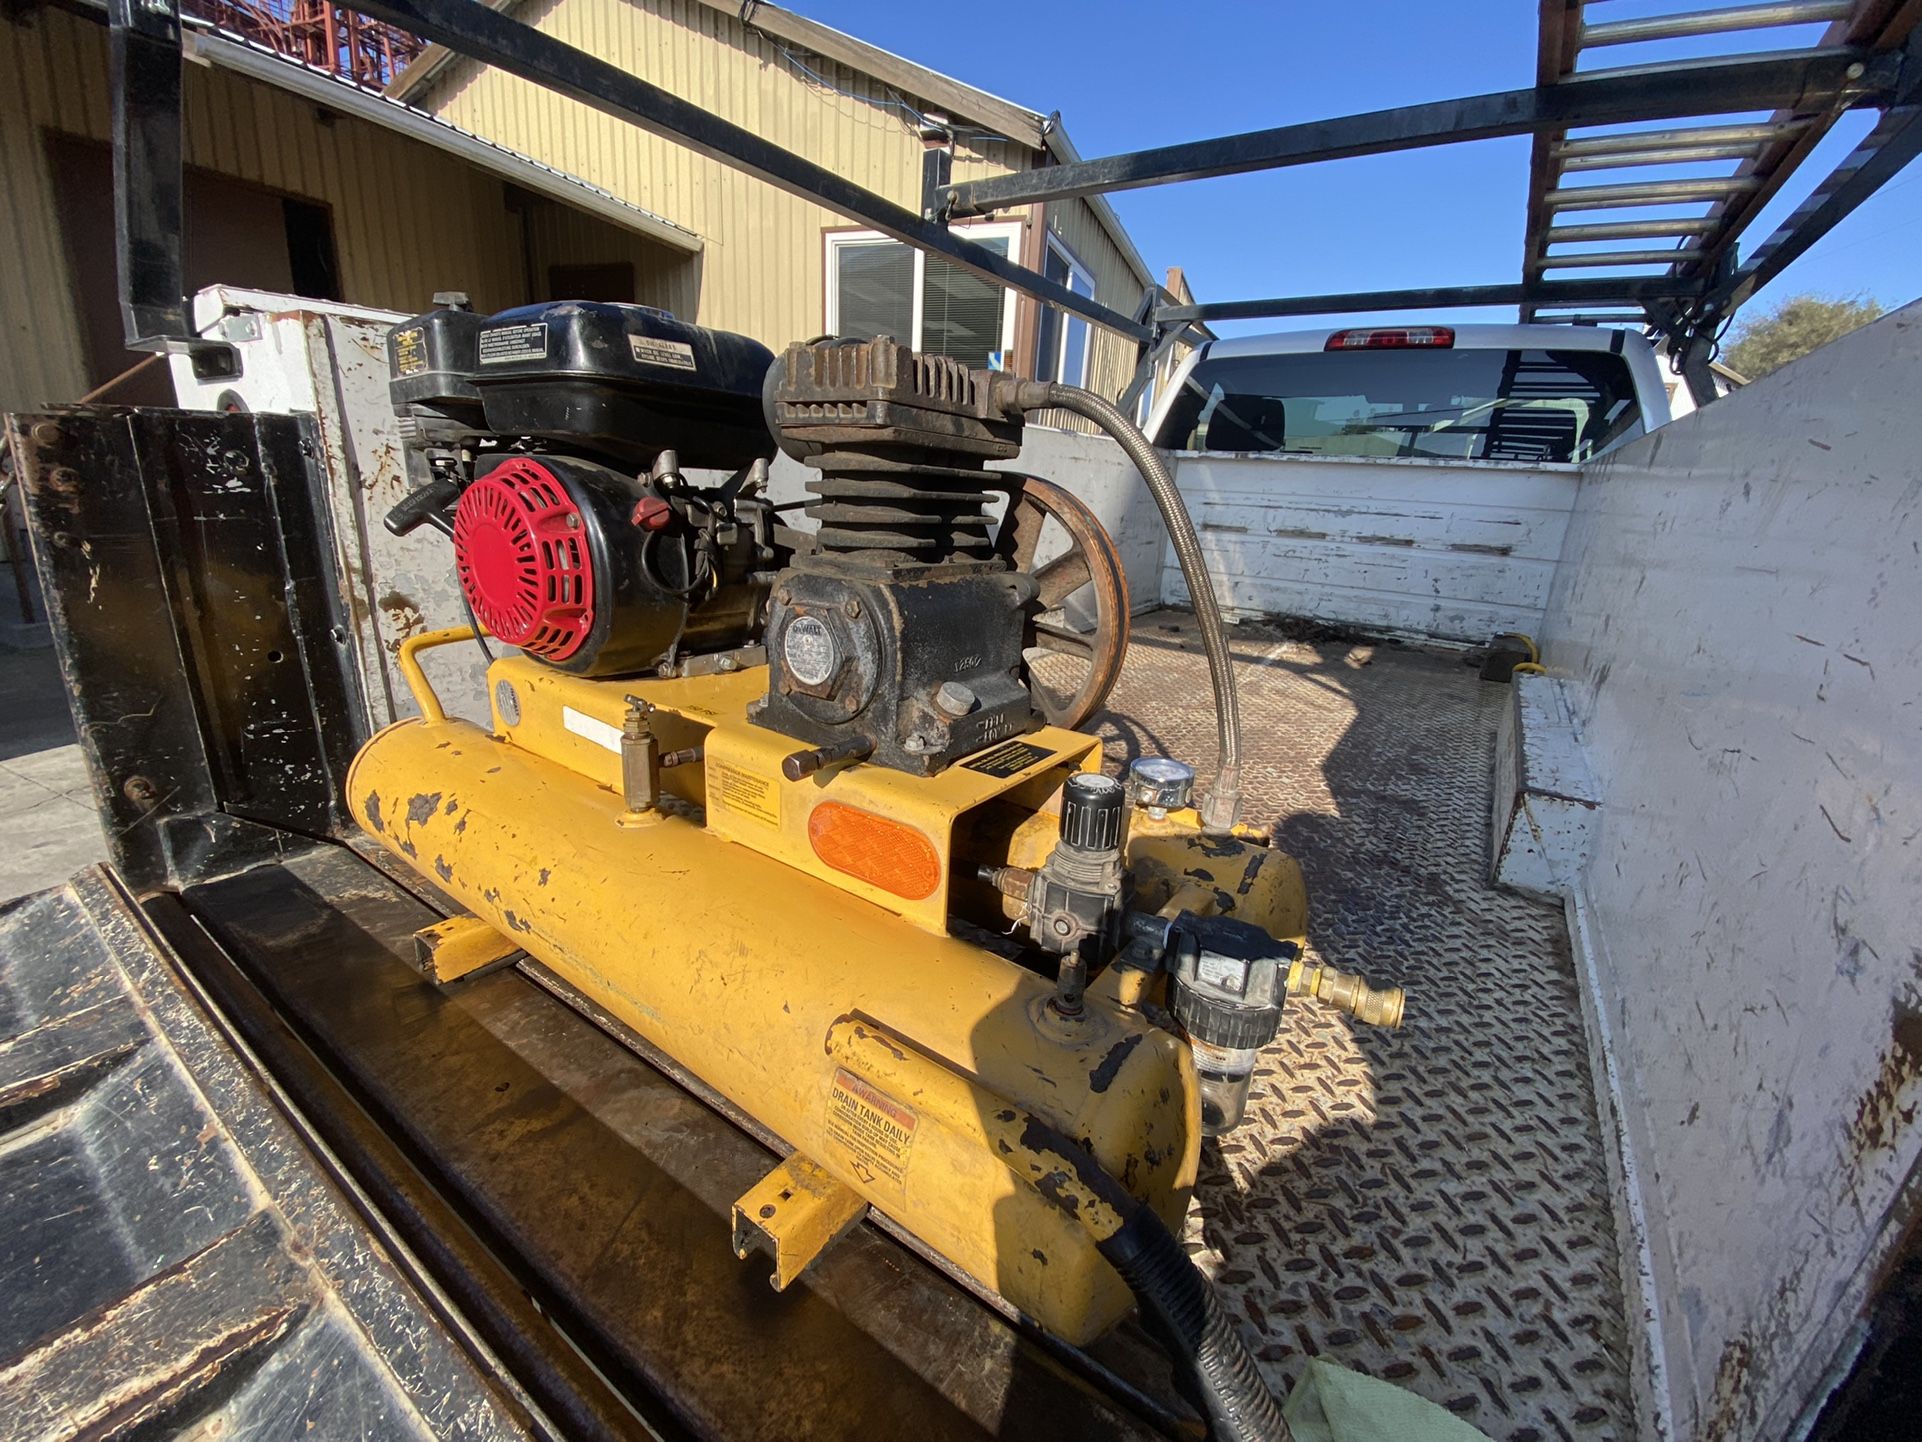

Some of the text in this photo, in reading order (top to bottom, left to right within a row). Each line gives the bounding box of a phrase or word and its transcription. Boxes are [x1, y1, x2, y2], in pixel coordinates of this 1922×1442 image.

[831, 1086, 910, 1146] DRAIN TANK DAILY
[857, 1087, 898, 1119] WARNING
